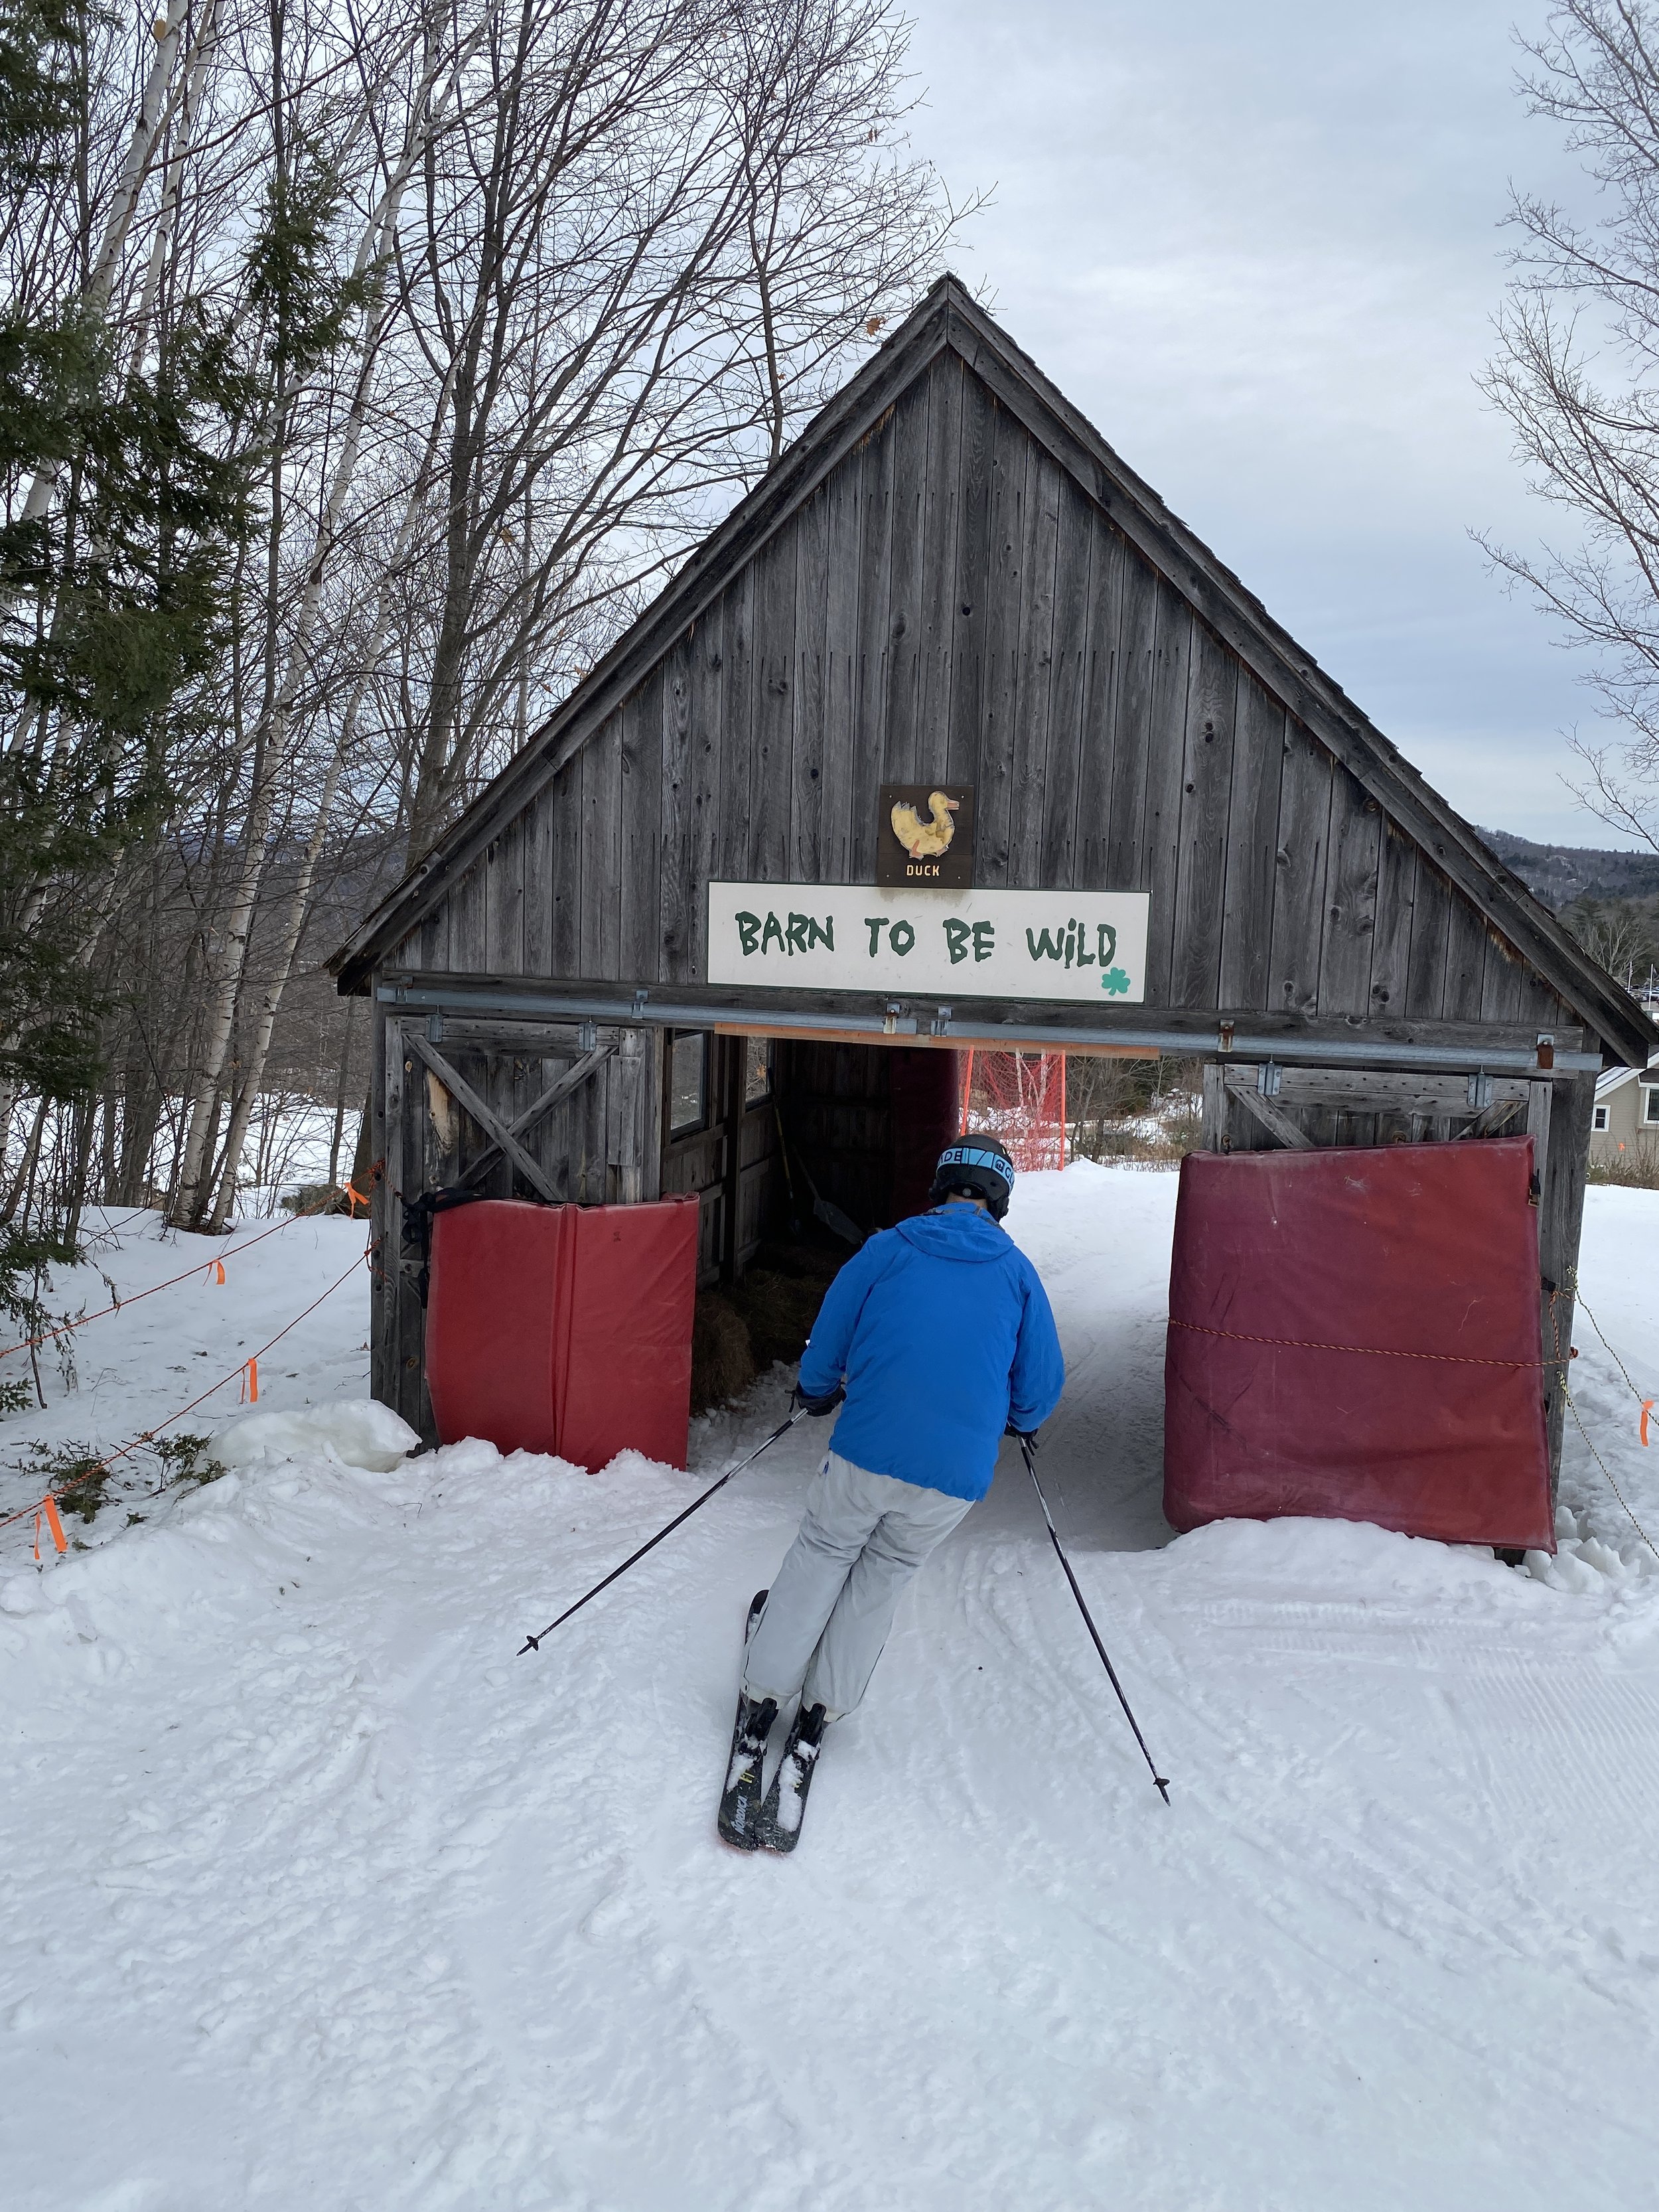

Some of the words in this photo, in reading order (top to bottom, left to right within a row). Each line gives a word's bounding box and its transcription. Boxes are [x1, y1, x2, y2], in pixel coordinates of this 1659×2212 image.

[906, 864, 940, 877] DUCK
[735, 911, 835, 956] BARN
[864, 917, 915, 958] TO
[942, 917, 995, 964] BE
[731, 1795, 747, 1836] NORDICA
